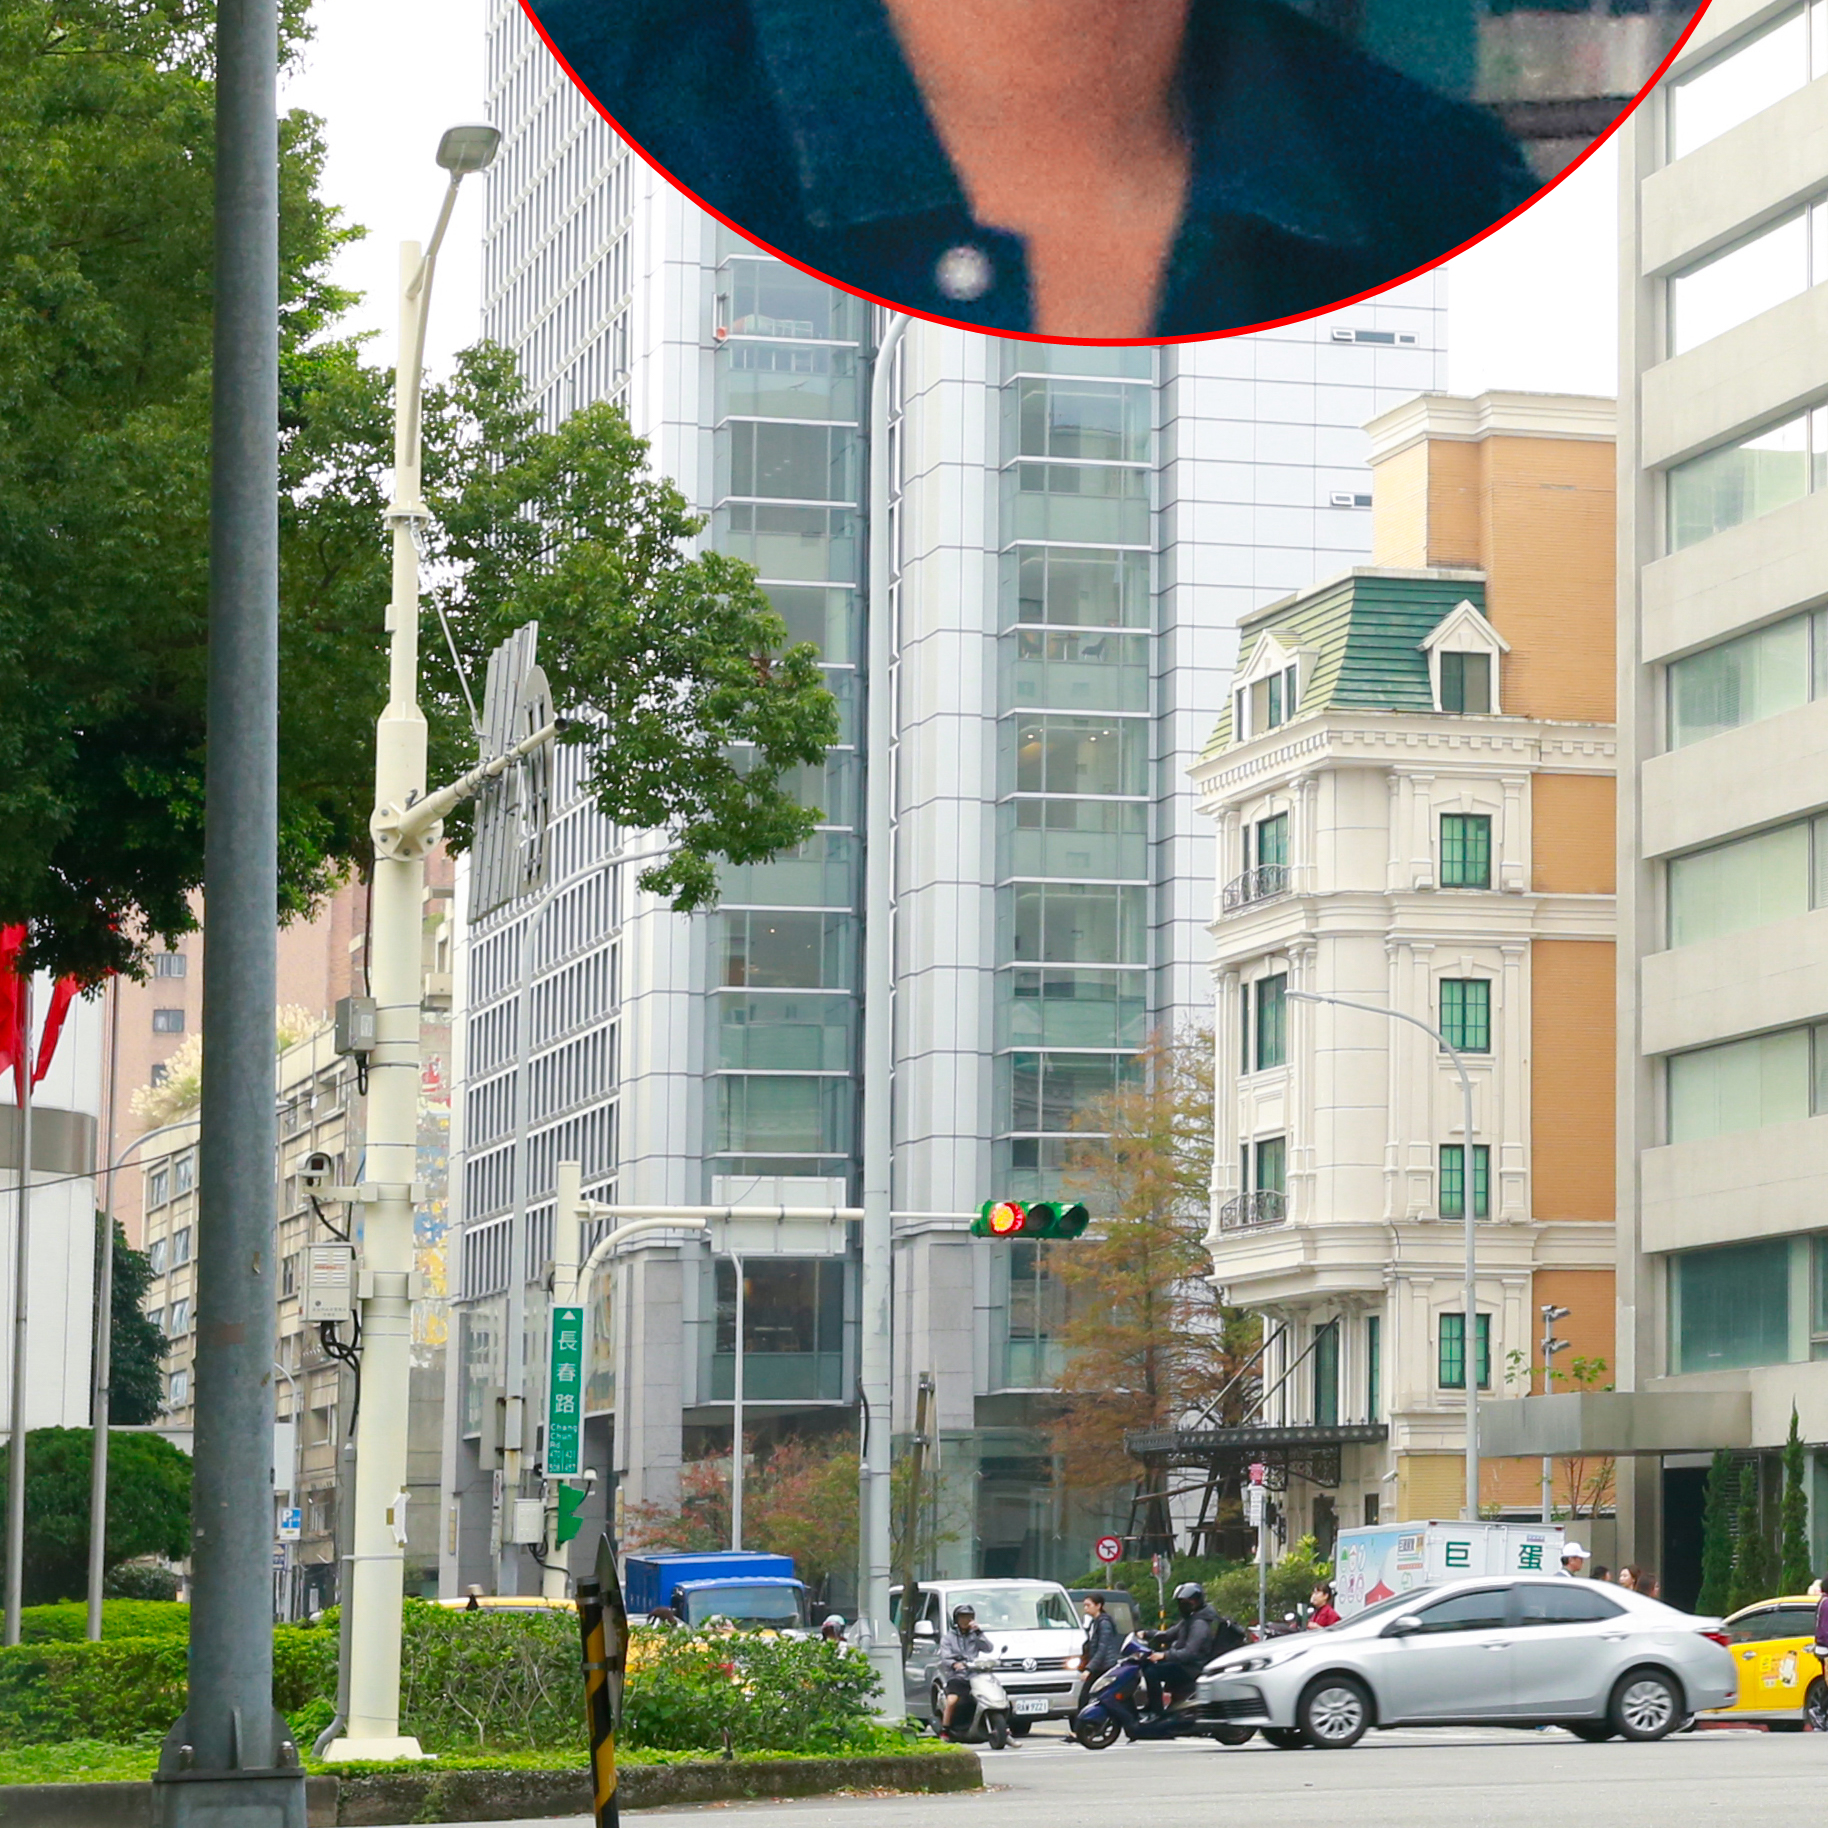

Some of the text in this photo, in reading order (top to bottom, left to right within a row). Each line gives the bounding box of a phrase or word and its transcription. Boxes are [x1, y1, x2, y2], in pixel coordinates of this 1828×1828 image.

[554, 1330, 578, 1413] 長春路
[550, 1423, 578, 1433] Chang
[550, 1432, 572, 1440] Chun
